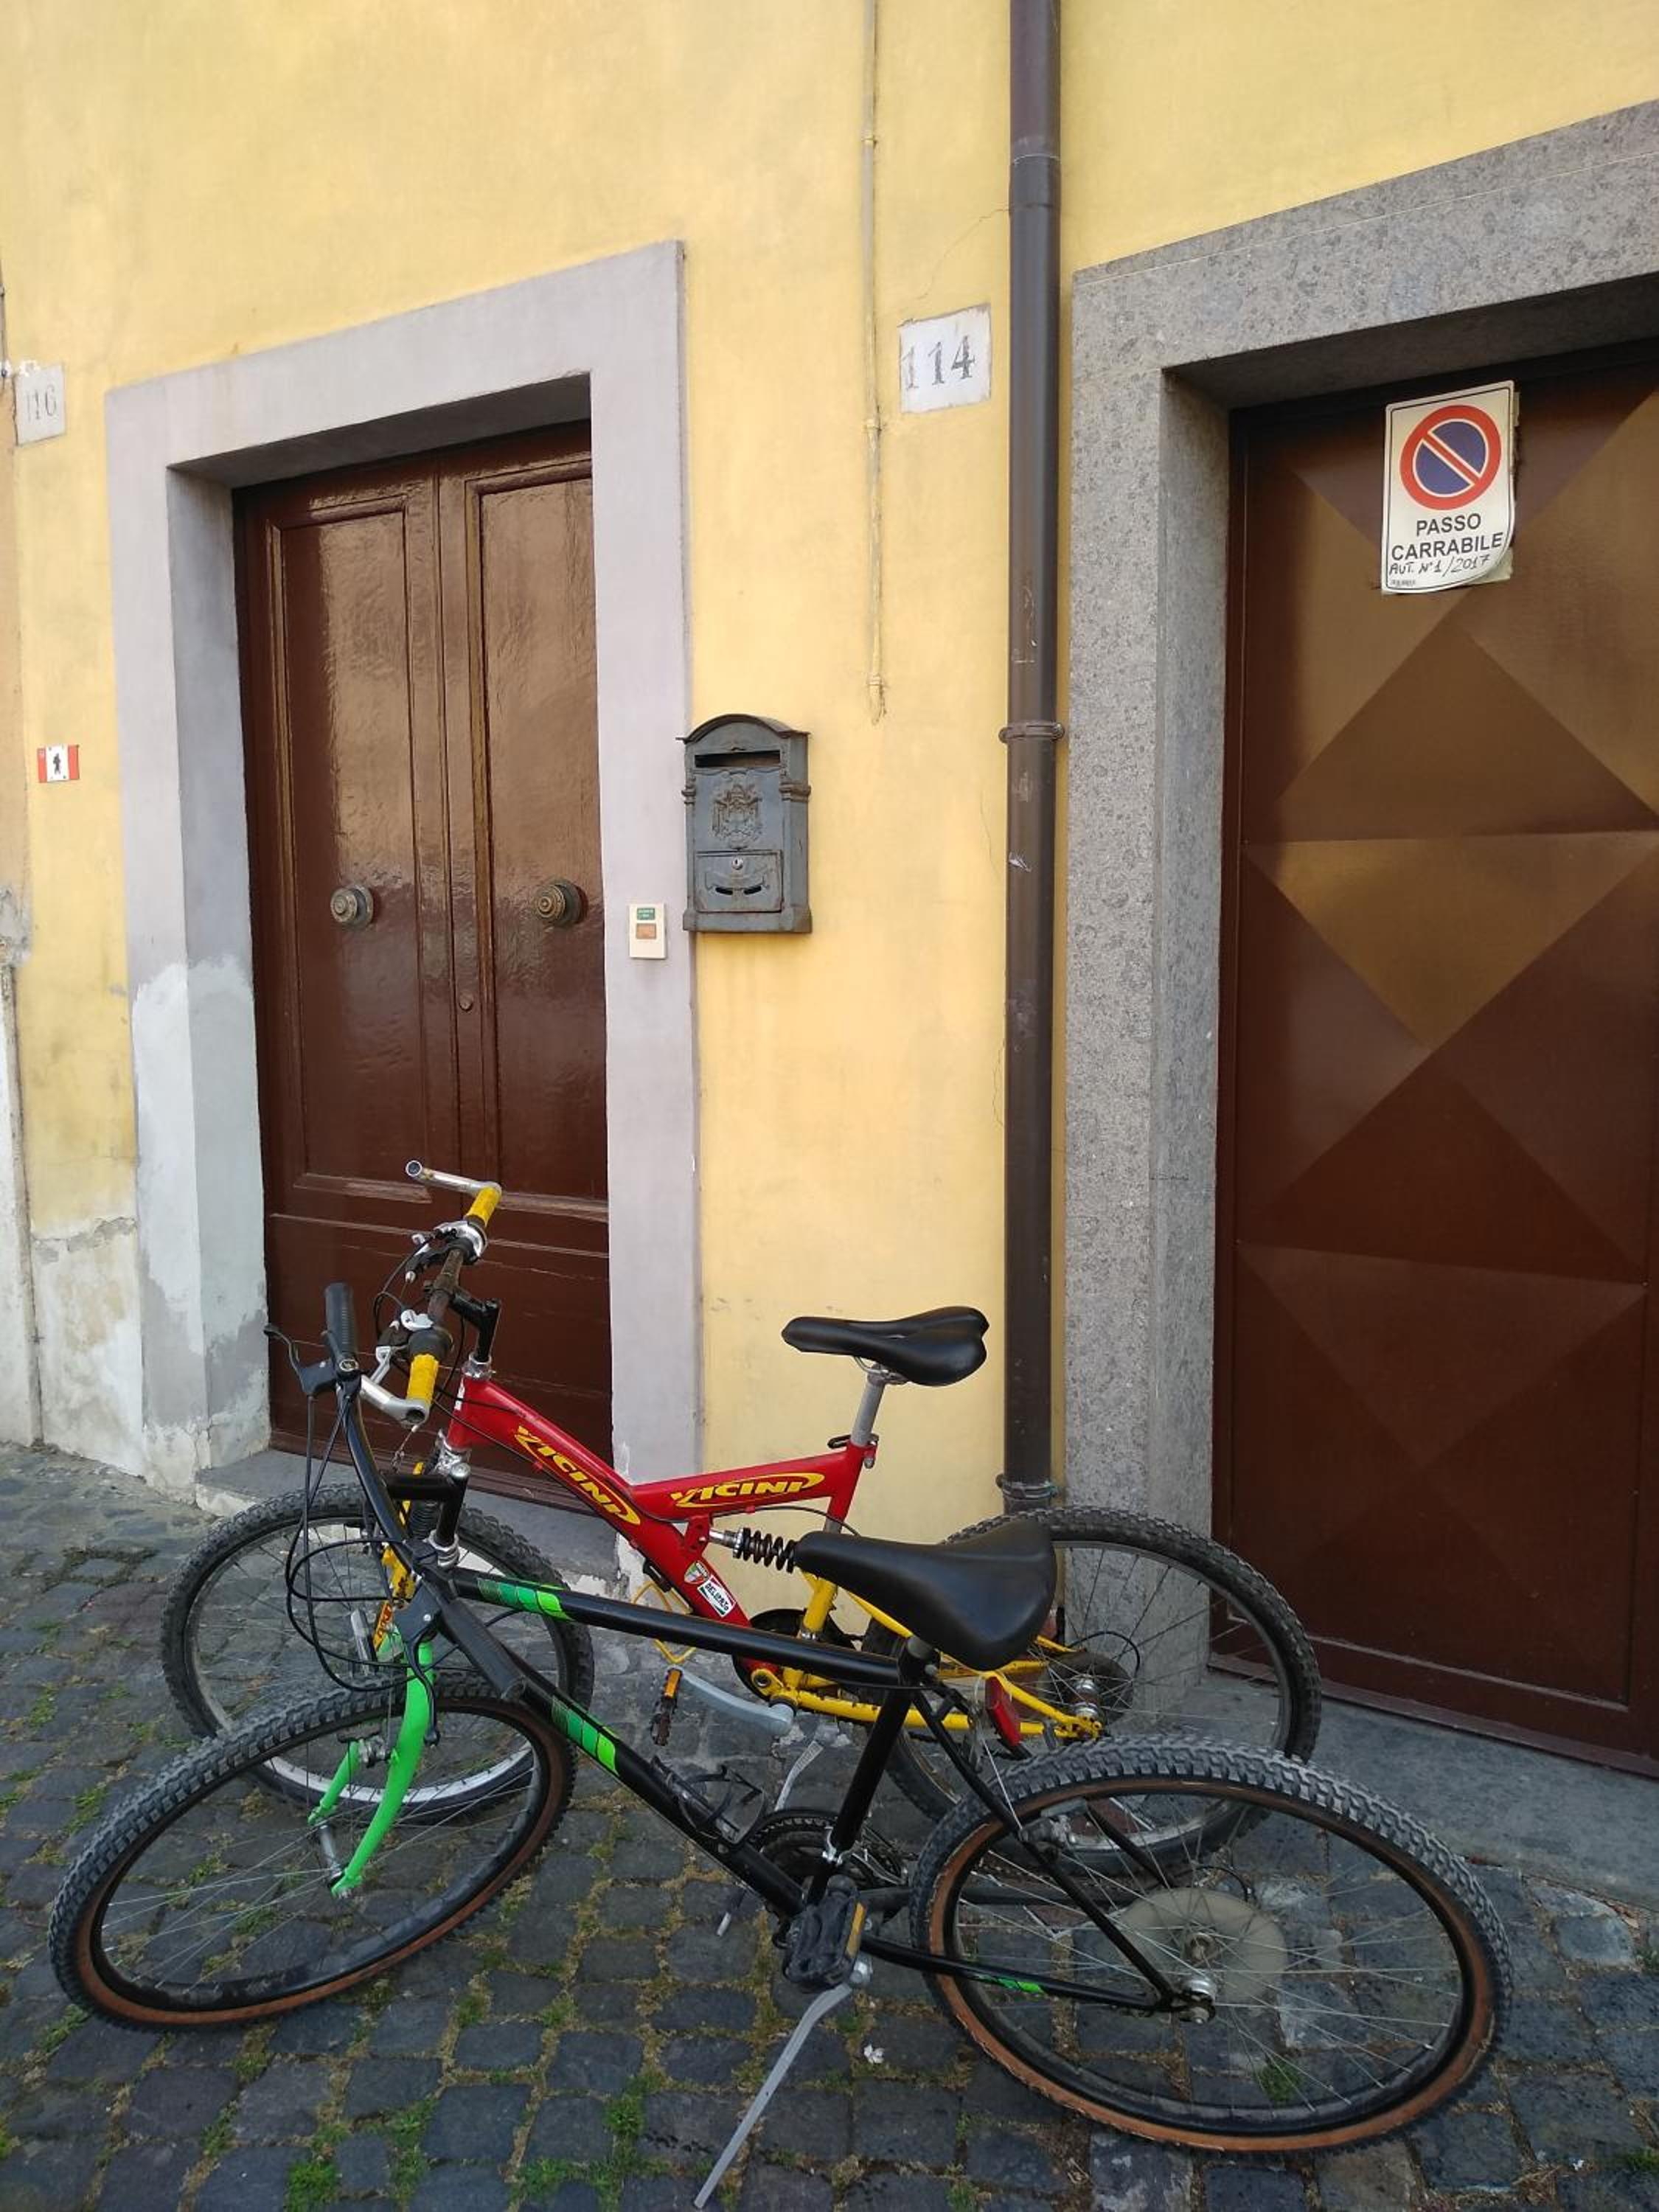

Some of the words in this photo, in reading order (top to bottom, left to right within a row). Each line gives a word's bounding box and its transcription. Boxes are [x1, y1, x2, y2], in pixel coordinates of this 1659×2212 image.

[900, 335, 976, 391] 114
[1416, 512, 1482, 537] PASSO
[1391, 532, 1504, 561] CARRABILE
[516, 1425, 623, 1514] VICINI
[670, 1481, 804, 1506] VICINI
